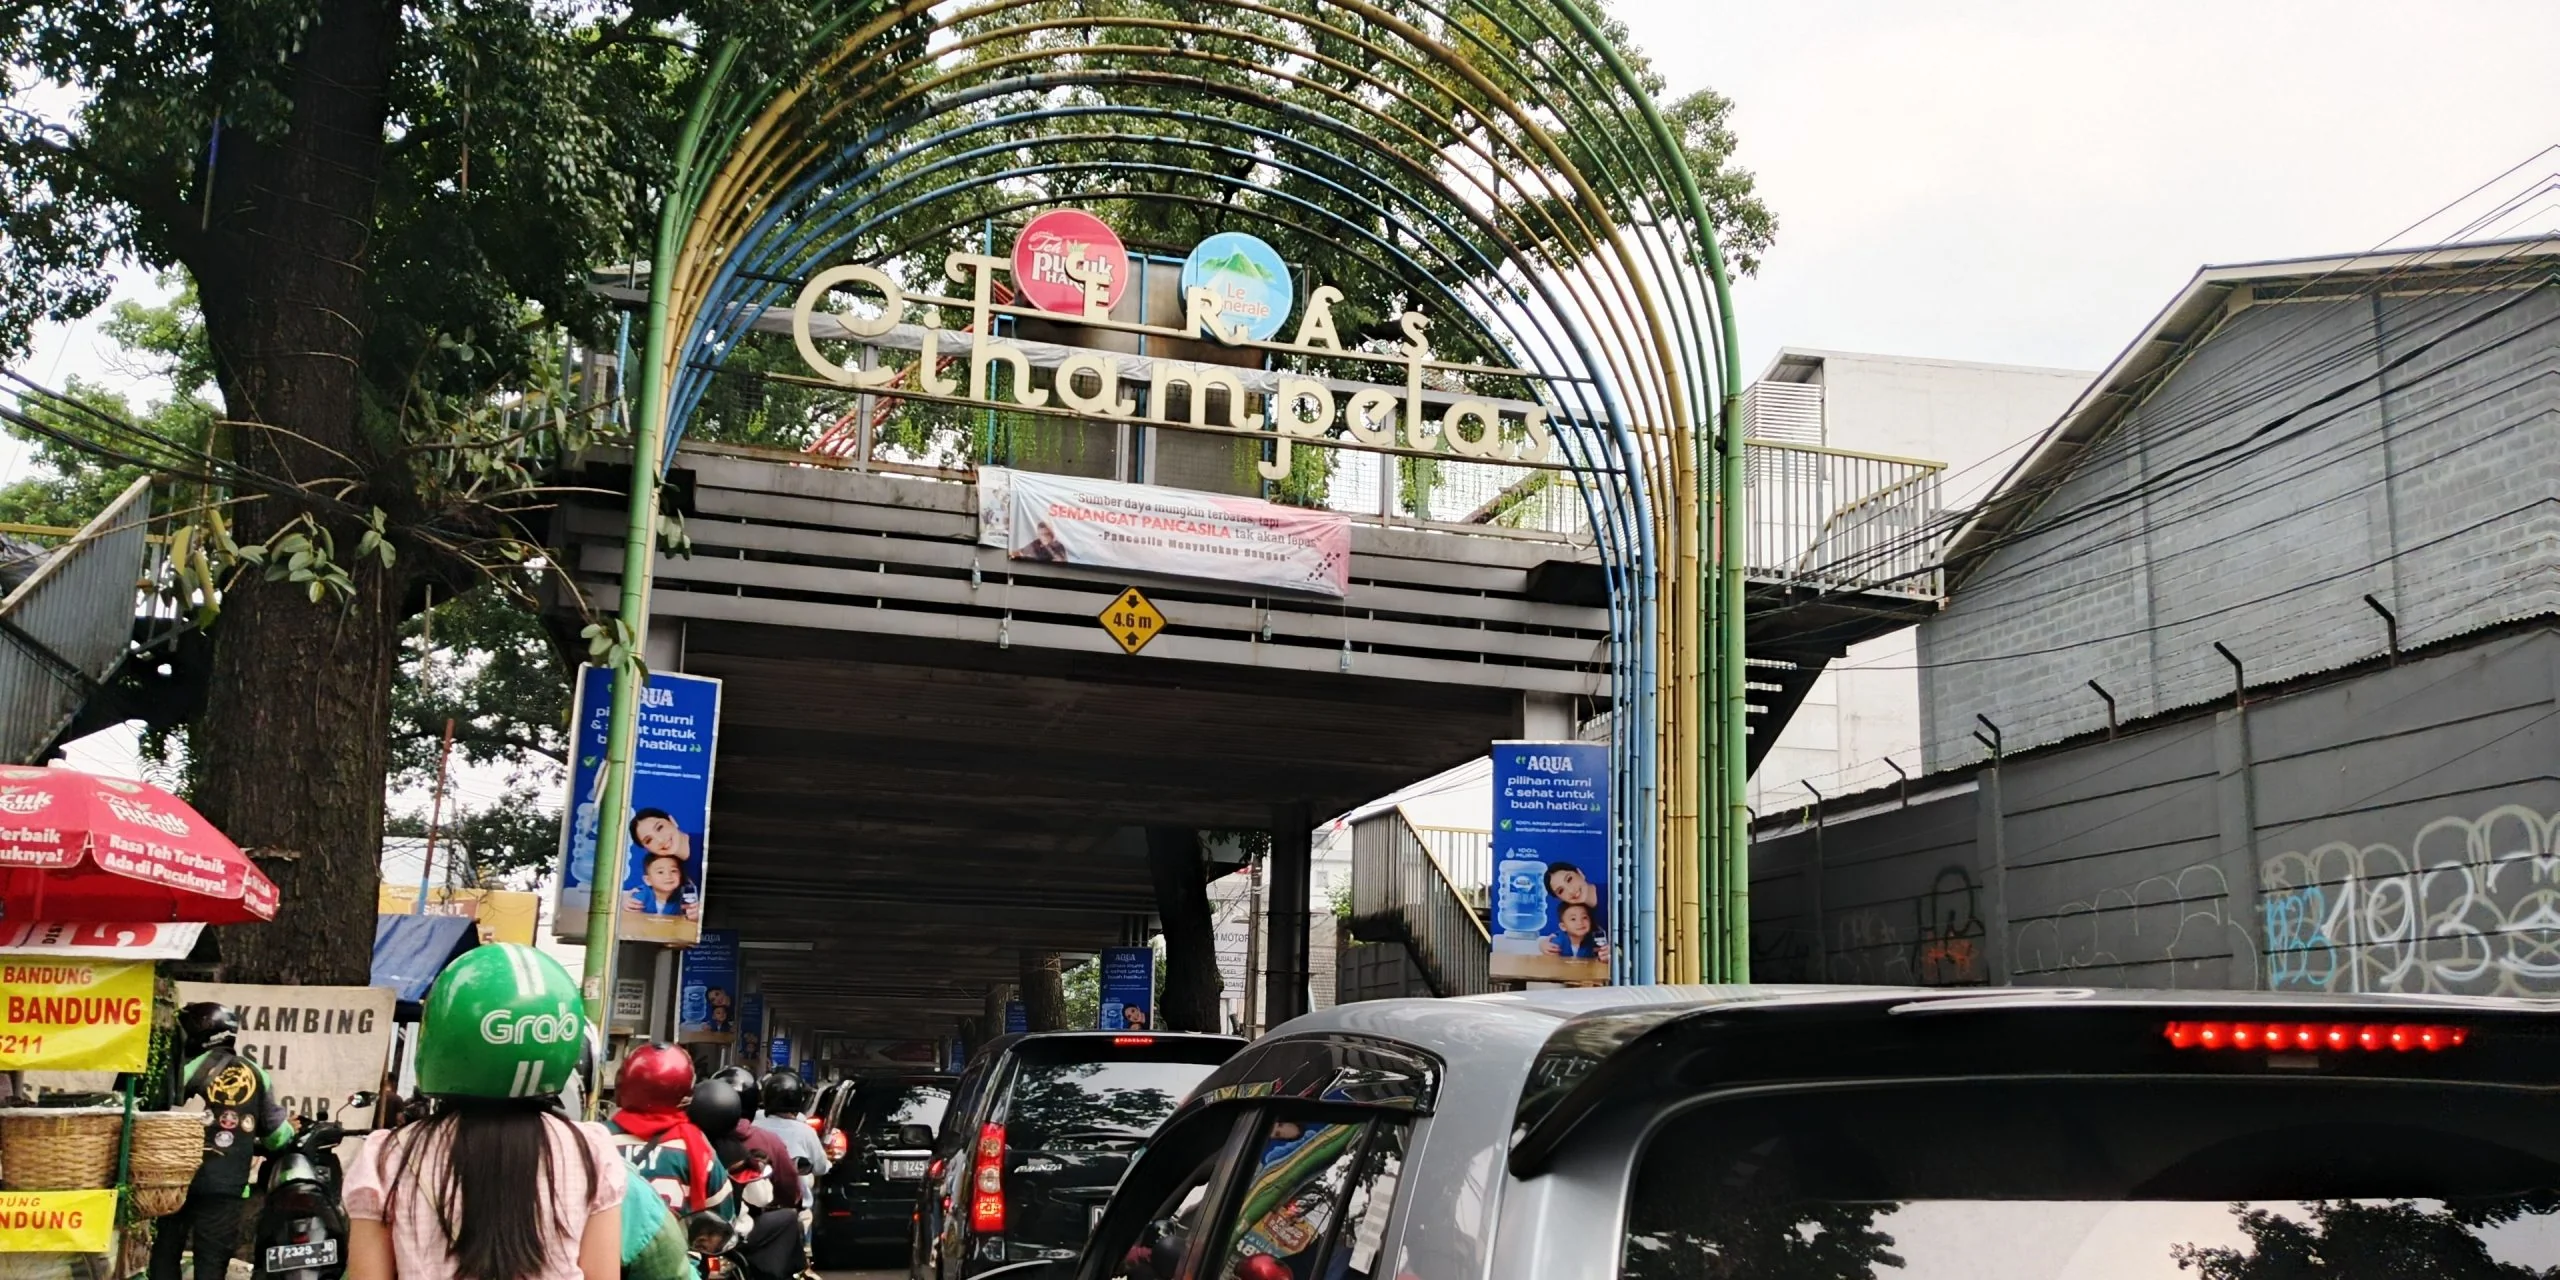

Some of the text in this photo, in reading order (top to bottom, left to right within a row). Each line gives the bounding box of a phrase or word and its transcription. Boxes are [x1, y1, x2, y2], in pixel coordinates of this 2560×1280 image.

[1032, 252, 1113, 280] puuk
[1227, 282, 1246, 299] Le
[945, 251, 1431, 359] TERAS
[1223, 300, 1270, 317] nerale
[793, 265, 1551, 481] Cihampelas
[1049, 504, 1139, 527] SEMANGAT
[1141, 515, 1231, 539] PANCASILA
[1235, 528, 1254, 541] tak
[1257, 532, 1285, 545] akan
[1125, 499, 1151, 514] daya
[1154, 502, 1204, 518] mungkin
[1259, 516, 1280, 531] tapi
[1113, 612, 1152, 629] 4.6 m
[640, 686, 674, 708] QUA
[649, 713, 694, 726] murni
[652, 727, 696, 740] untuk
[640, 738, 687, 753] hatiku
[1527, 755, 1574, 775] AQUA
[1508, 775, 1592, 787] pilihan murni
[1504, 788, 1595, 799] & sehat untuk
[1511, 799, 1588, 811] buah hatiku
[110, 834, 226, 874] Rasa Teh Terbaik
[104, 852, 133, 872] Ada
[136, 858, 151, 876] di
[153, 863, 228, 892] Pucuknya!
[3, 966, 93, 985] BANDUNG
[8, 996, 142, 1025] BANDUNG
[234, 1004, 375, 1034] KAMBING
[480, 1002, 579, 1044] Grab
[0, 1035, 43, 1054] 211
[269, 1249, 277, 1260] Z
